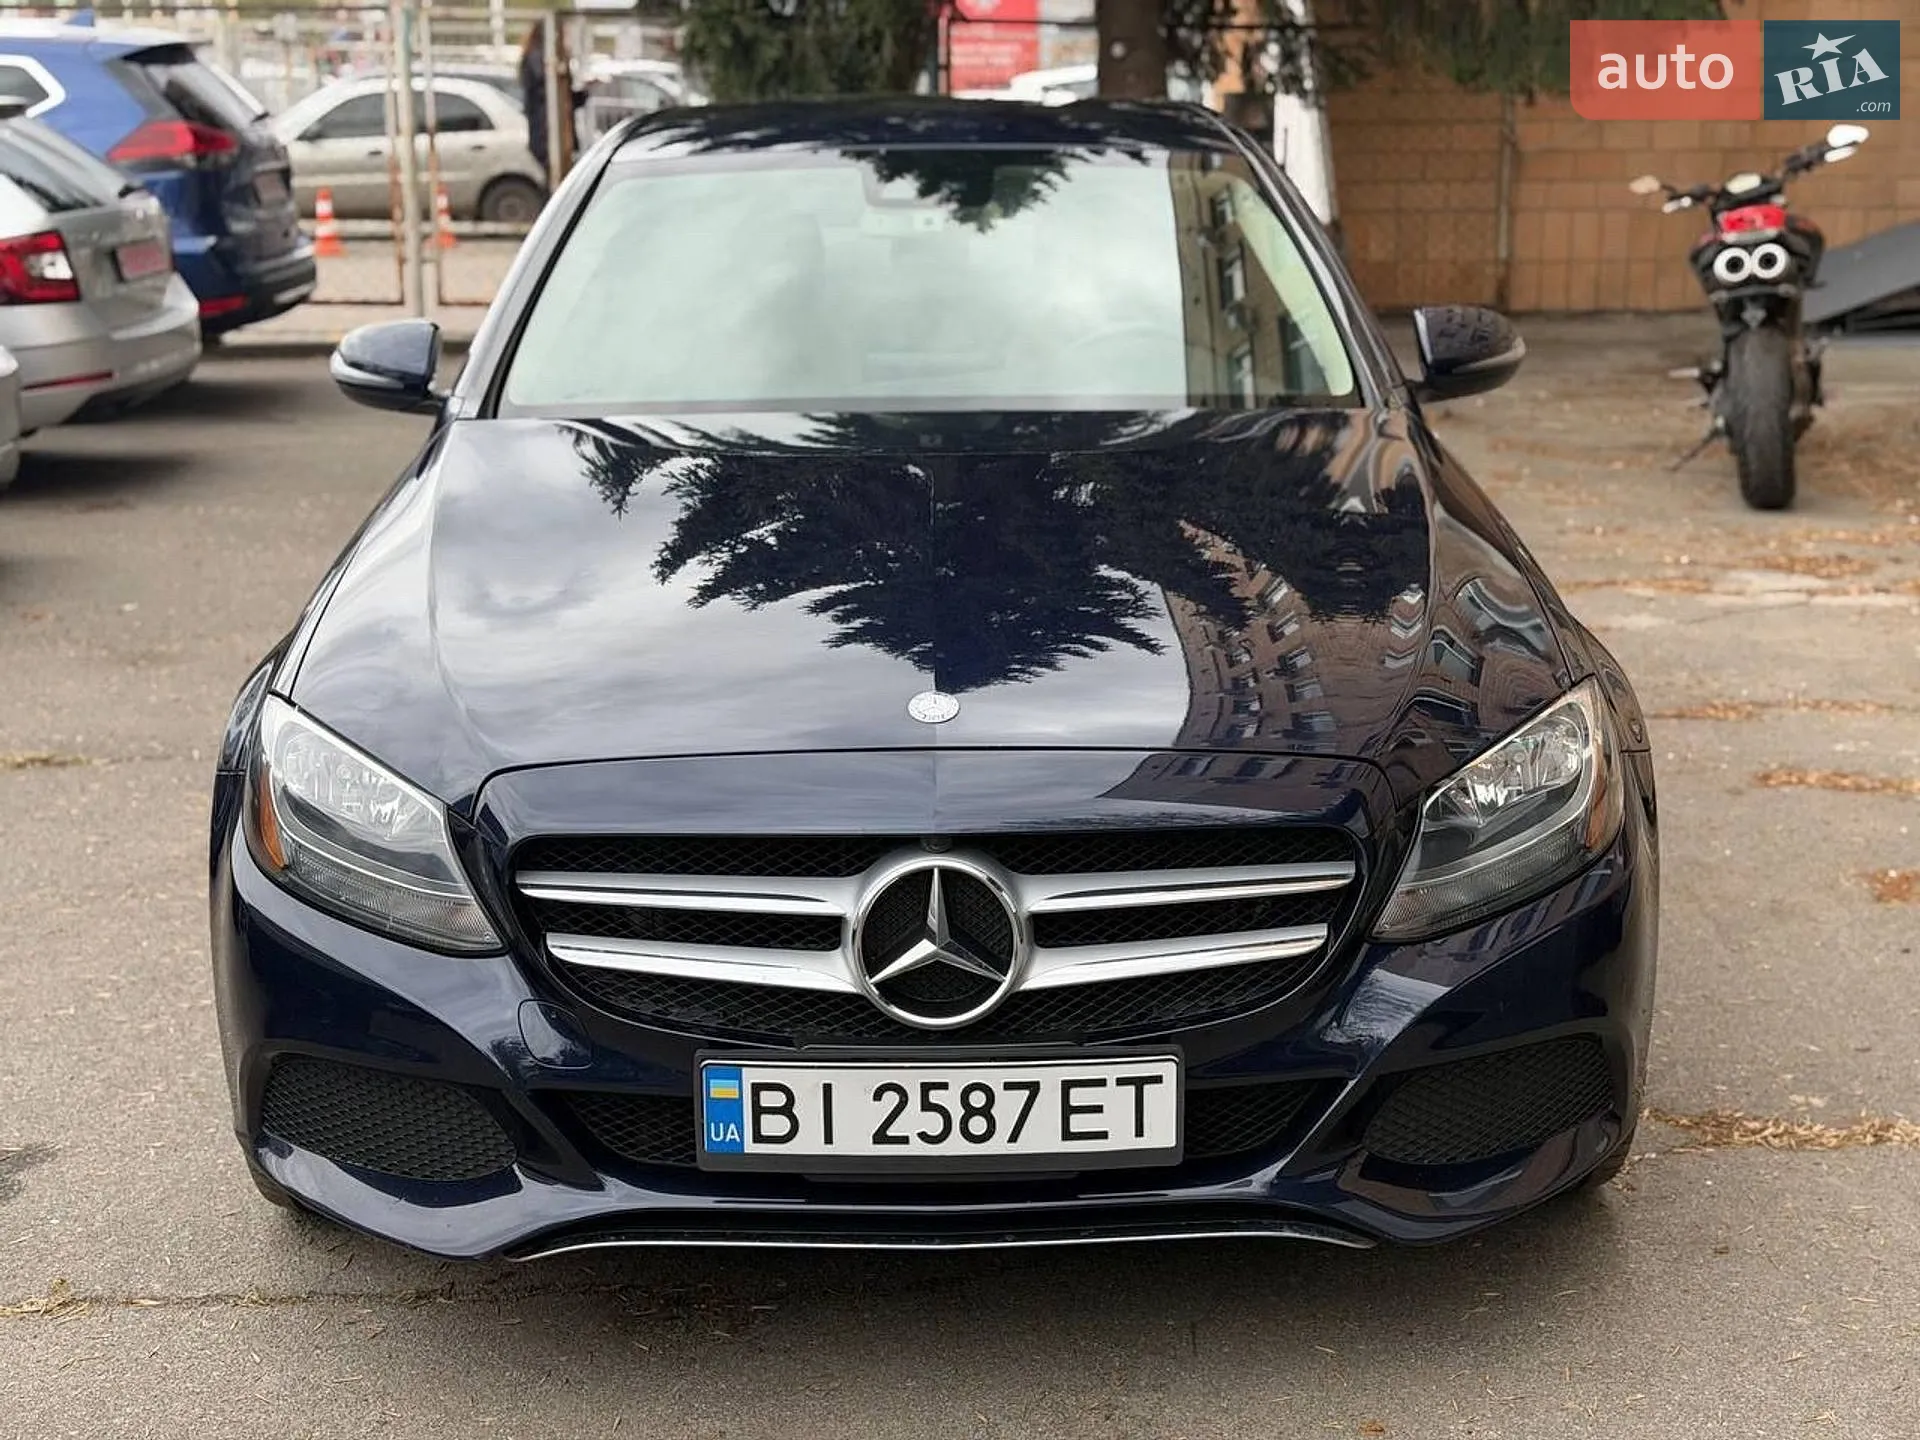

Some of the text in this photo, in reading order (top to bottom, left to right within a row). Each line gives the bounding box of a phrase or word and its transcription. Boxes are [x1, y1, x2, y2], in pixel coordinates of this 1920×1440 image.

[710, 1122, 740, 1143] UA
[750, 1075, 1165, 1145] BI 2587 ET
